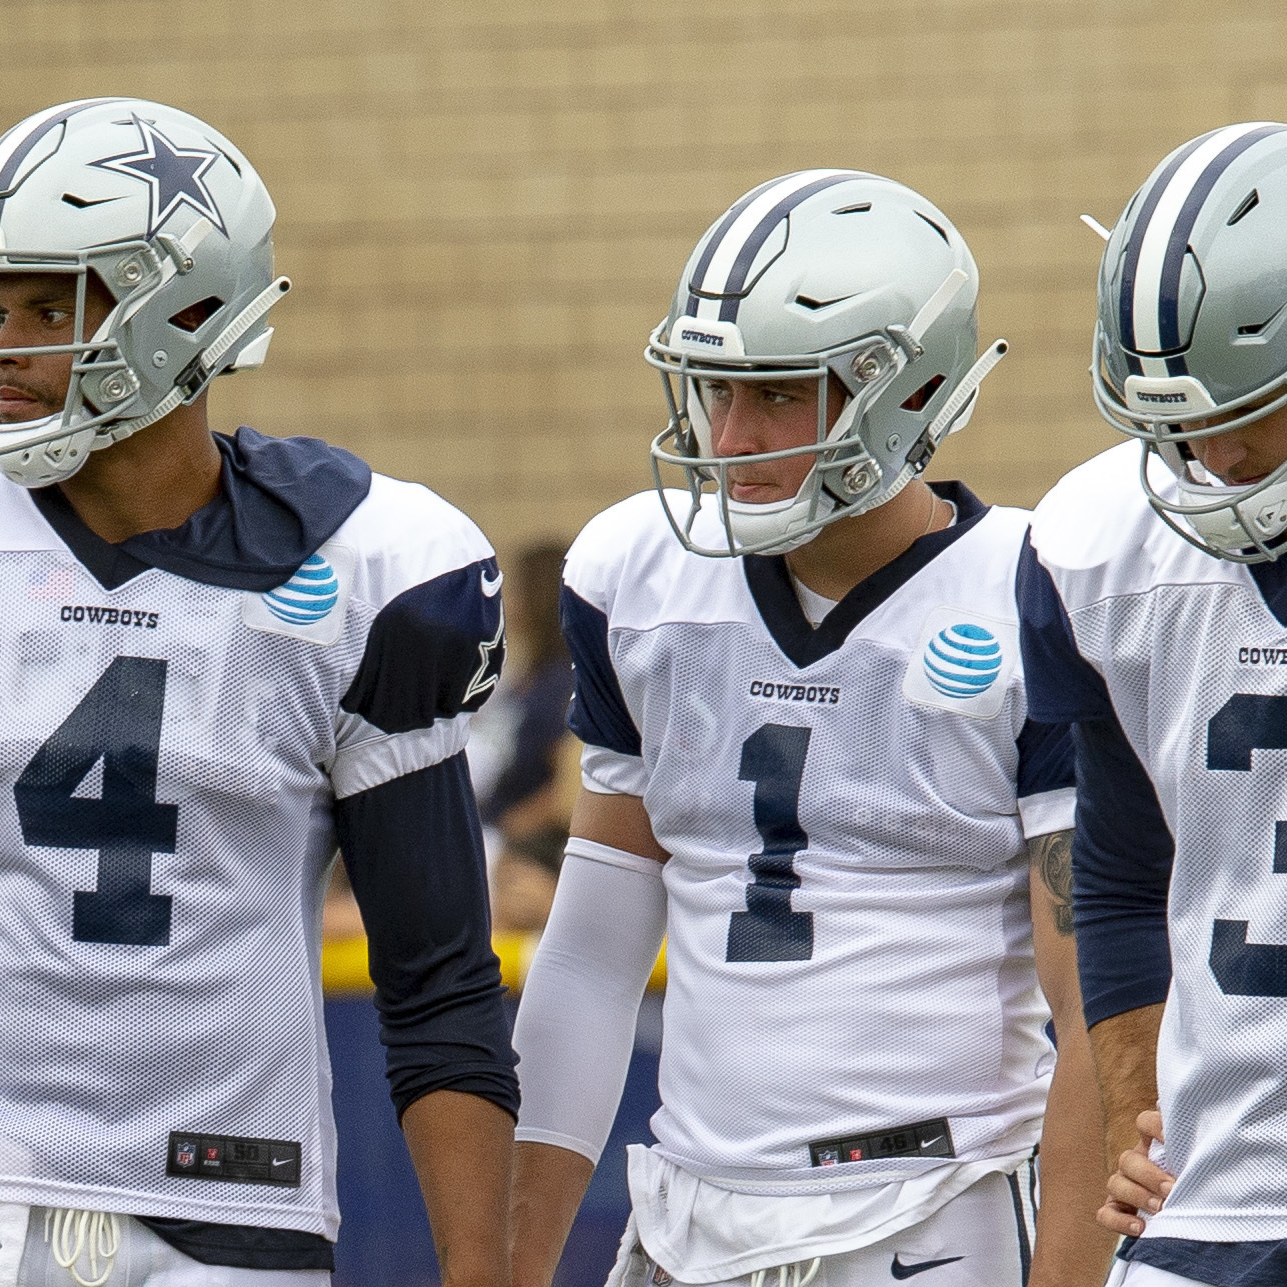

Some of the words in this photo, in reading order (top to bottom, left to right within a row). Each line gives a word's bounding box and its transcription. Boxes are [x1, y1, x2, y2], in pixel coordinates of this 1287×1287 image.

[682, 329, 724, 347] COWBOYS
[1136, 391, 1187, 403] COWBOYS
[60, 604, 159, 629] COWBOYS
[749, 680, 840, 704] COWBOYS
[13, 655, 178, 946] 4
[726, 722, 814, 962] 1
